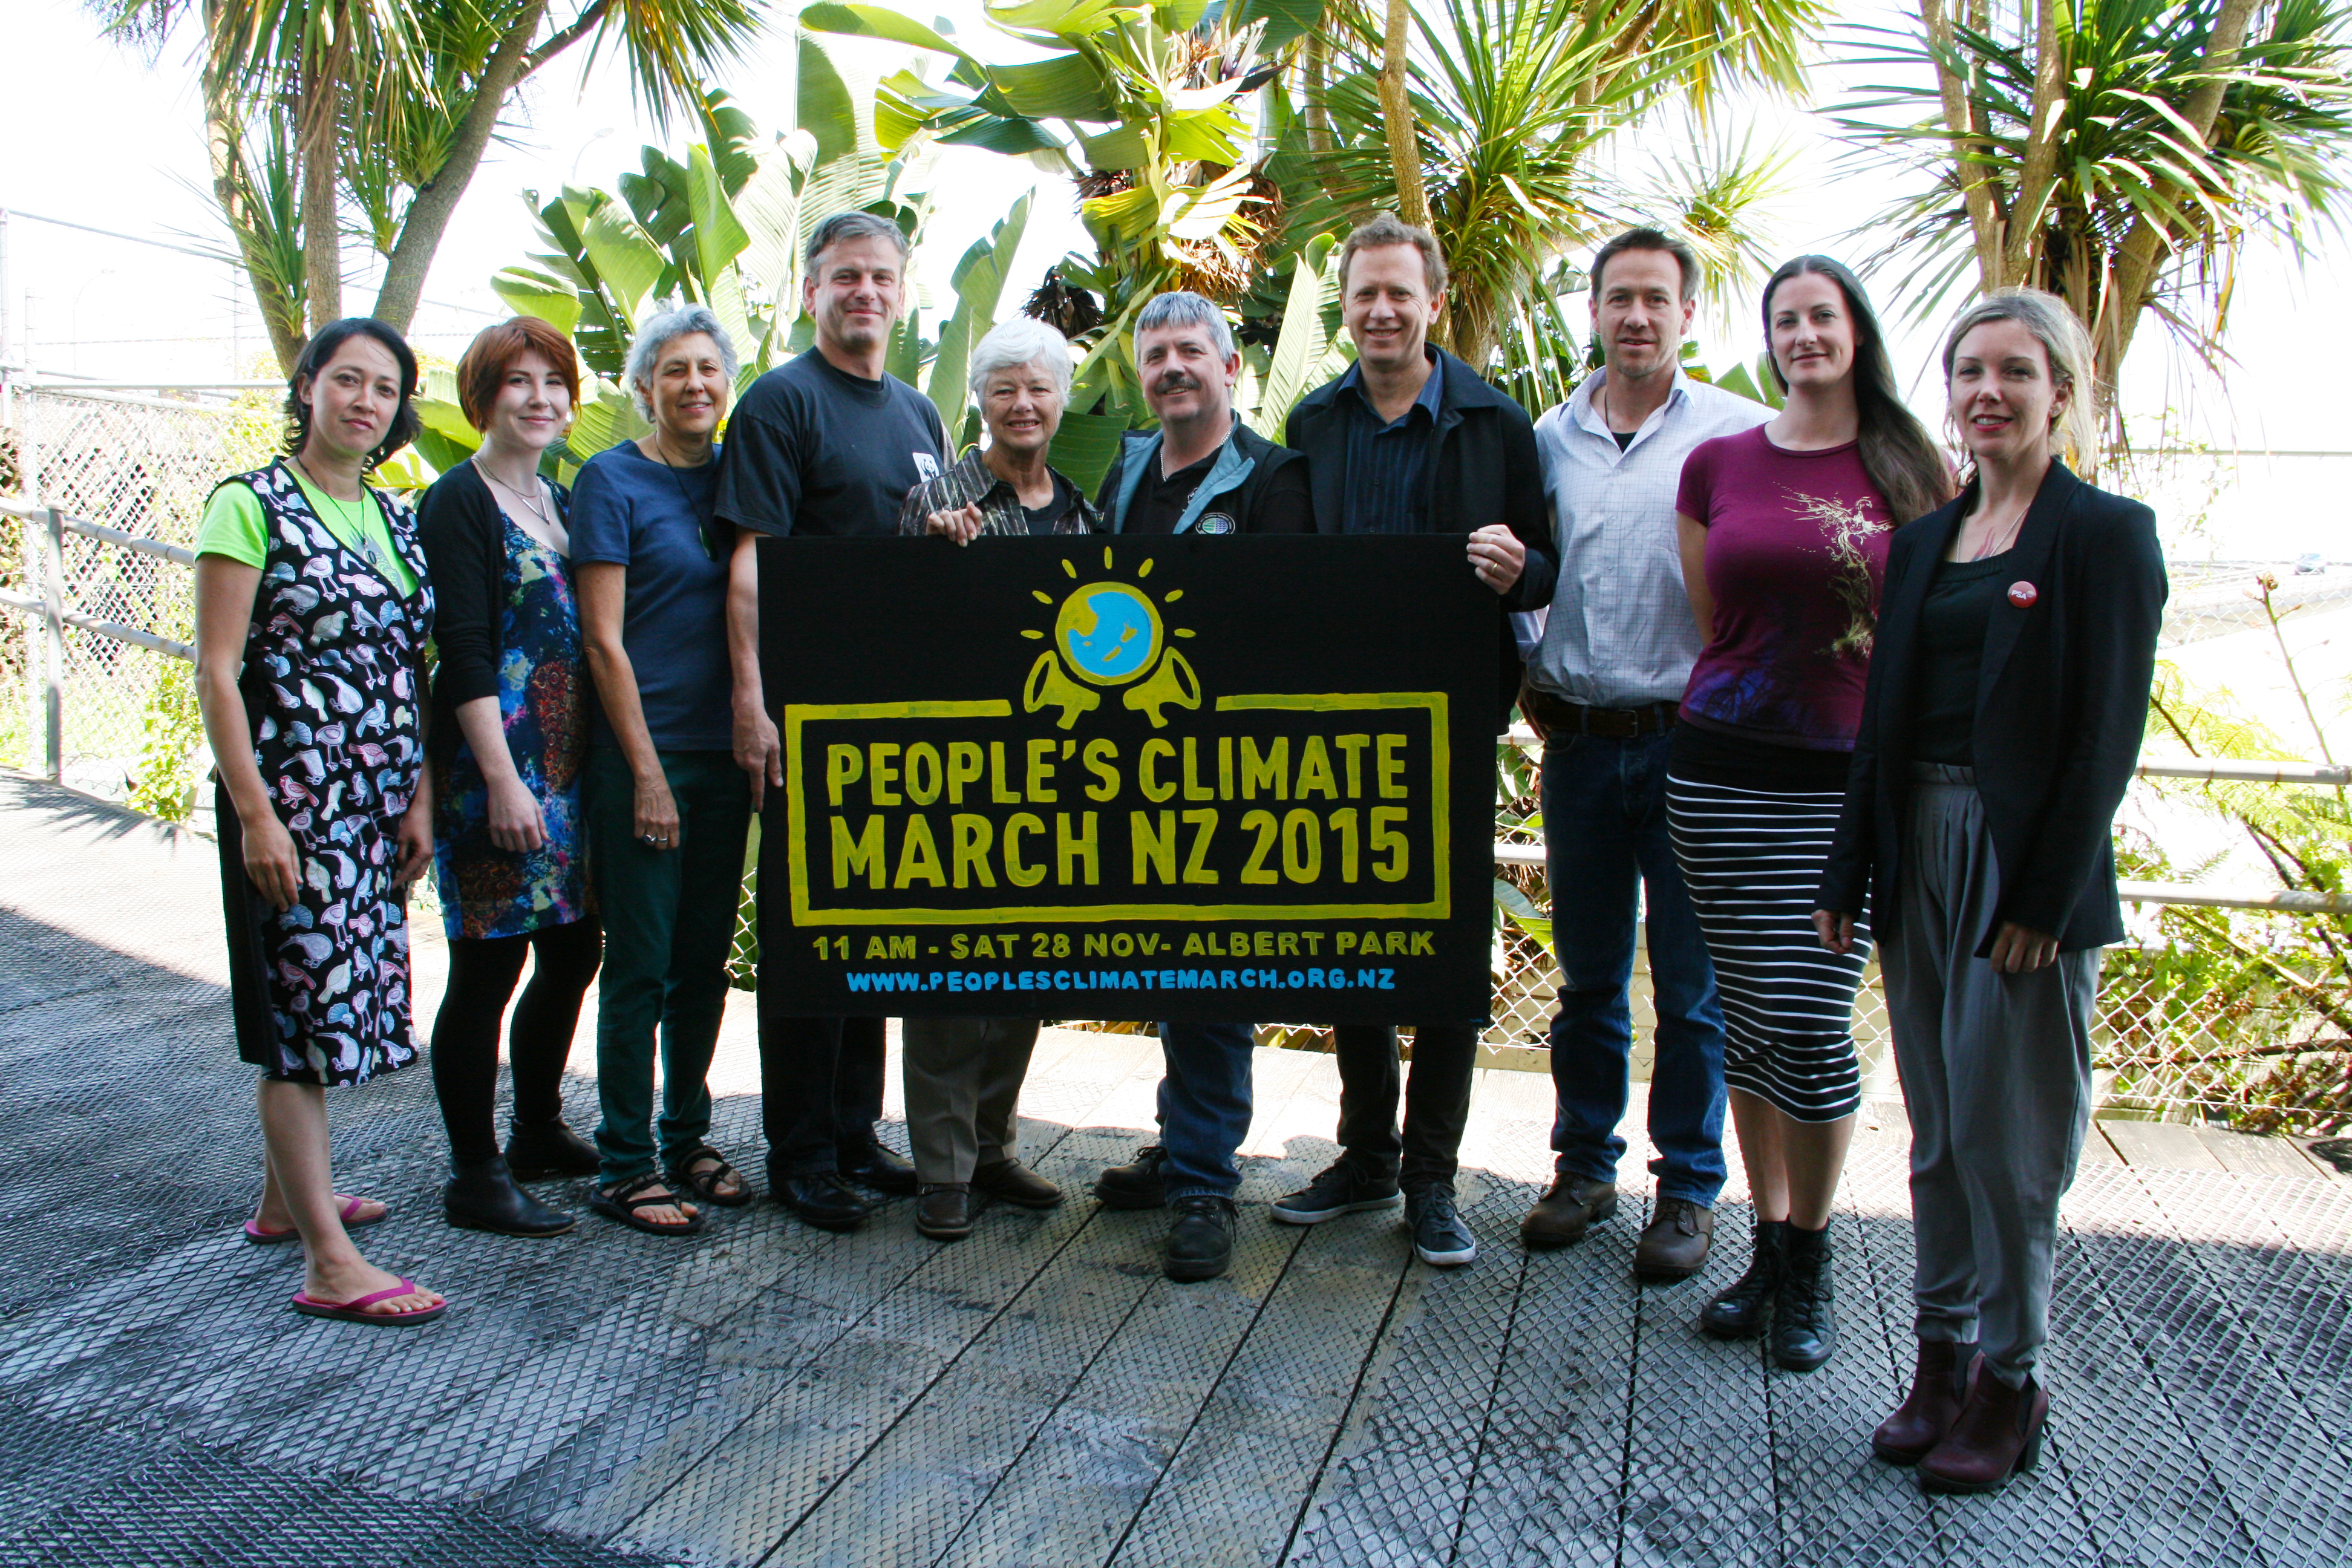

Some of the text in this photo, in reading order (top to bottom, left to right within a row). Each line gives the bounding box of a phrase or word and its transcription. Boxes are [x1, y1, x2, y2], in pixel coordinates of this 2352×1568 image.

[2011, 590, 2027, 599] PSA
[826, 734, 1408, 806] PEOPLE'S CLIMATE
[830, 806, 1409, 889] MARCH NZ 2015
[812, 935, 849, 961] 11
[865, 934, 916, 959] AM
[950, 933, 1020, 959] SAT
[1031, 932, 1071, 958] 28
[1183, 931, 1325, 956] ALBERT
[1336, 930, 1436, 956] PARK
[846, 968, 1396, 992] WWW.PEOPLESCLIMATEMARCH.ORG.NZ
